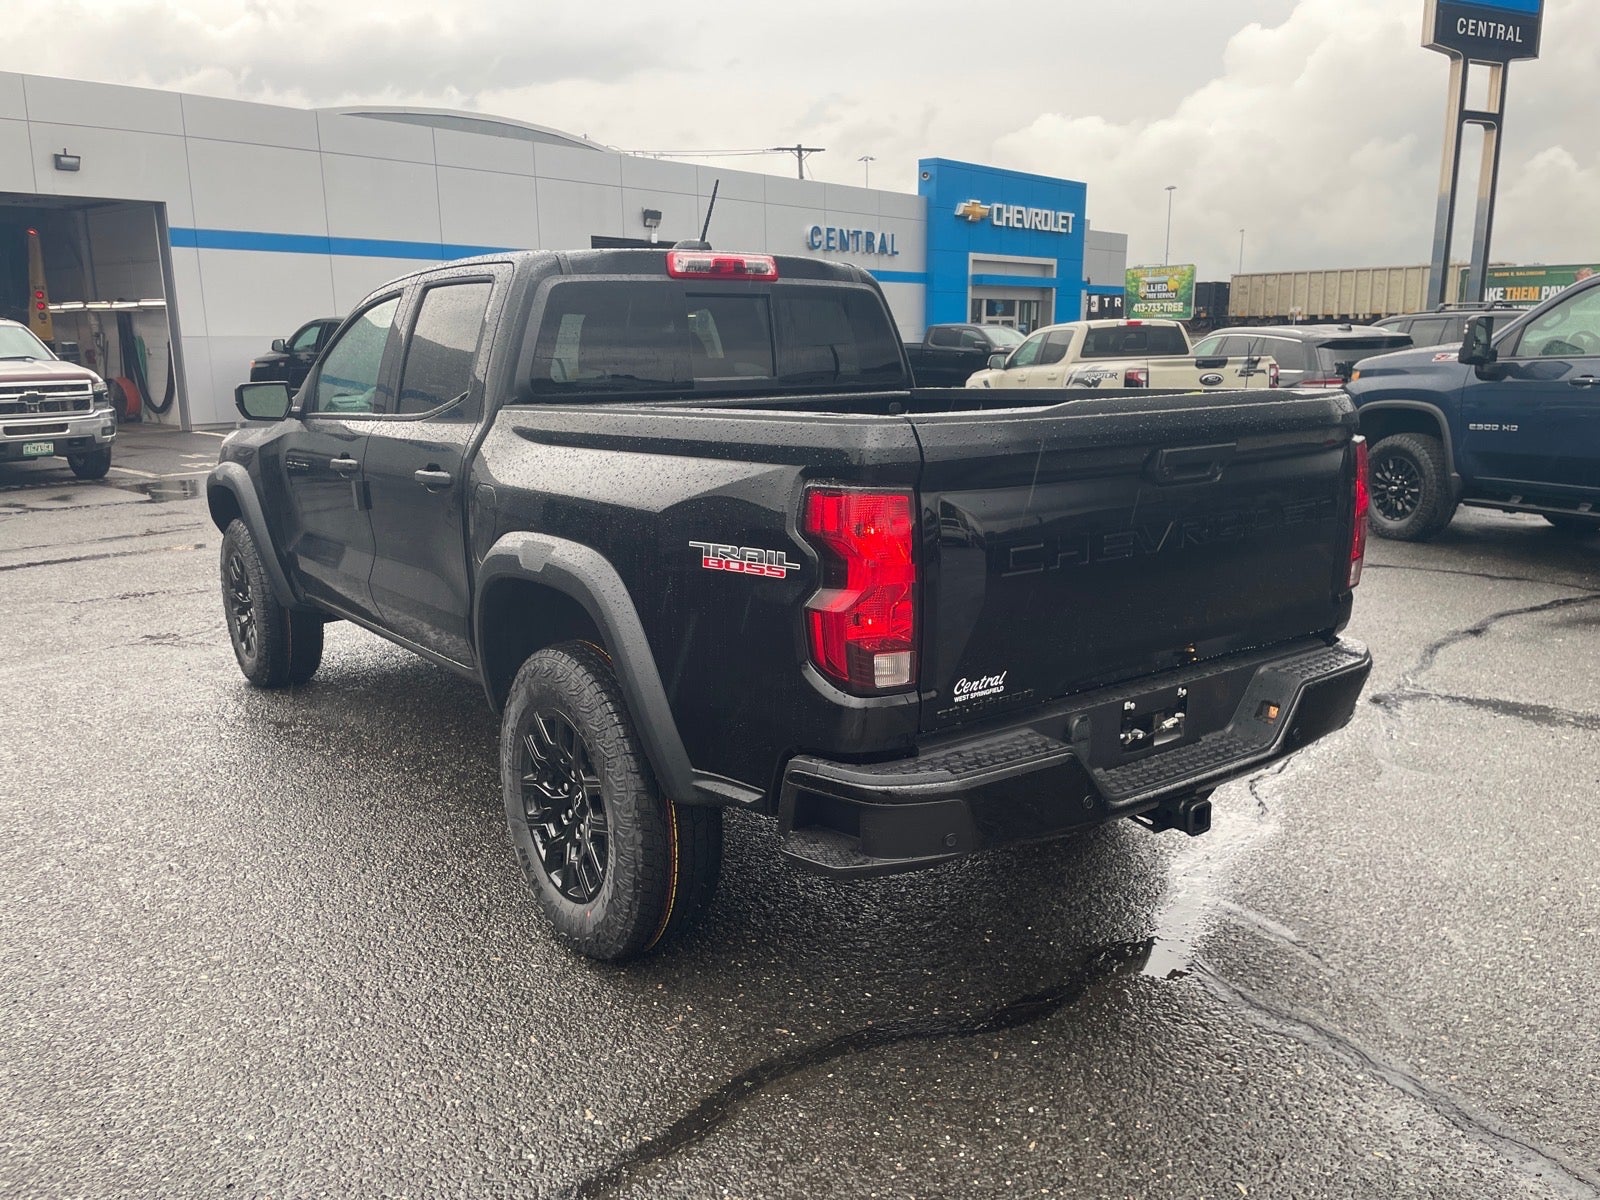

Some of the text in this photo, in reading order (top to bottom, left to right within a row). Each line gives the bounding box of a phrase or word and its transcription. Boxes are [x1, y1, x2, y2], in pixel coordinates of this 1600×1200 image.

[1456, 17, 1523, 43] CENTRAL
[991, 203, 1075, 233] CHEVROLET
[808, 225, 900, 256] CENTRAL
[1505, 285, 1540, 300] THEM
[689, 541, 800, 569] TRAIL
[702, 556, 786, 579] BOSS
[953, 671, 1007, 695] Central
[953, 685, 1004, 703] WEST SPRINGFIELD
